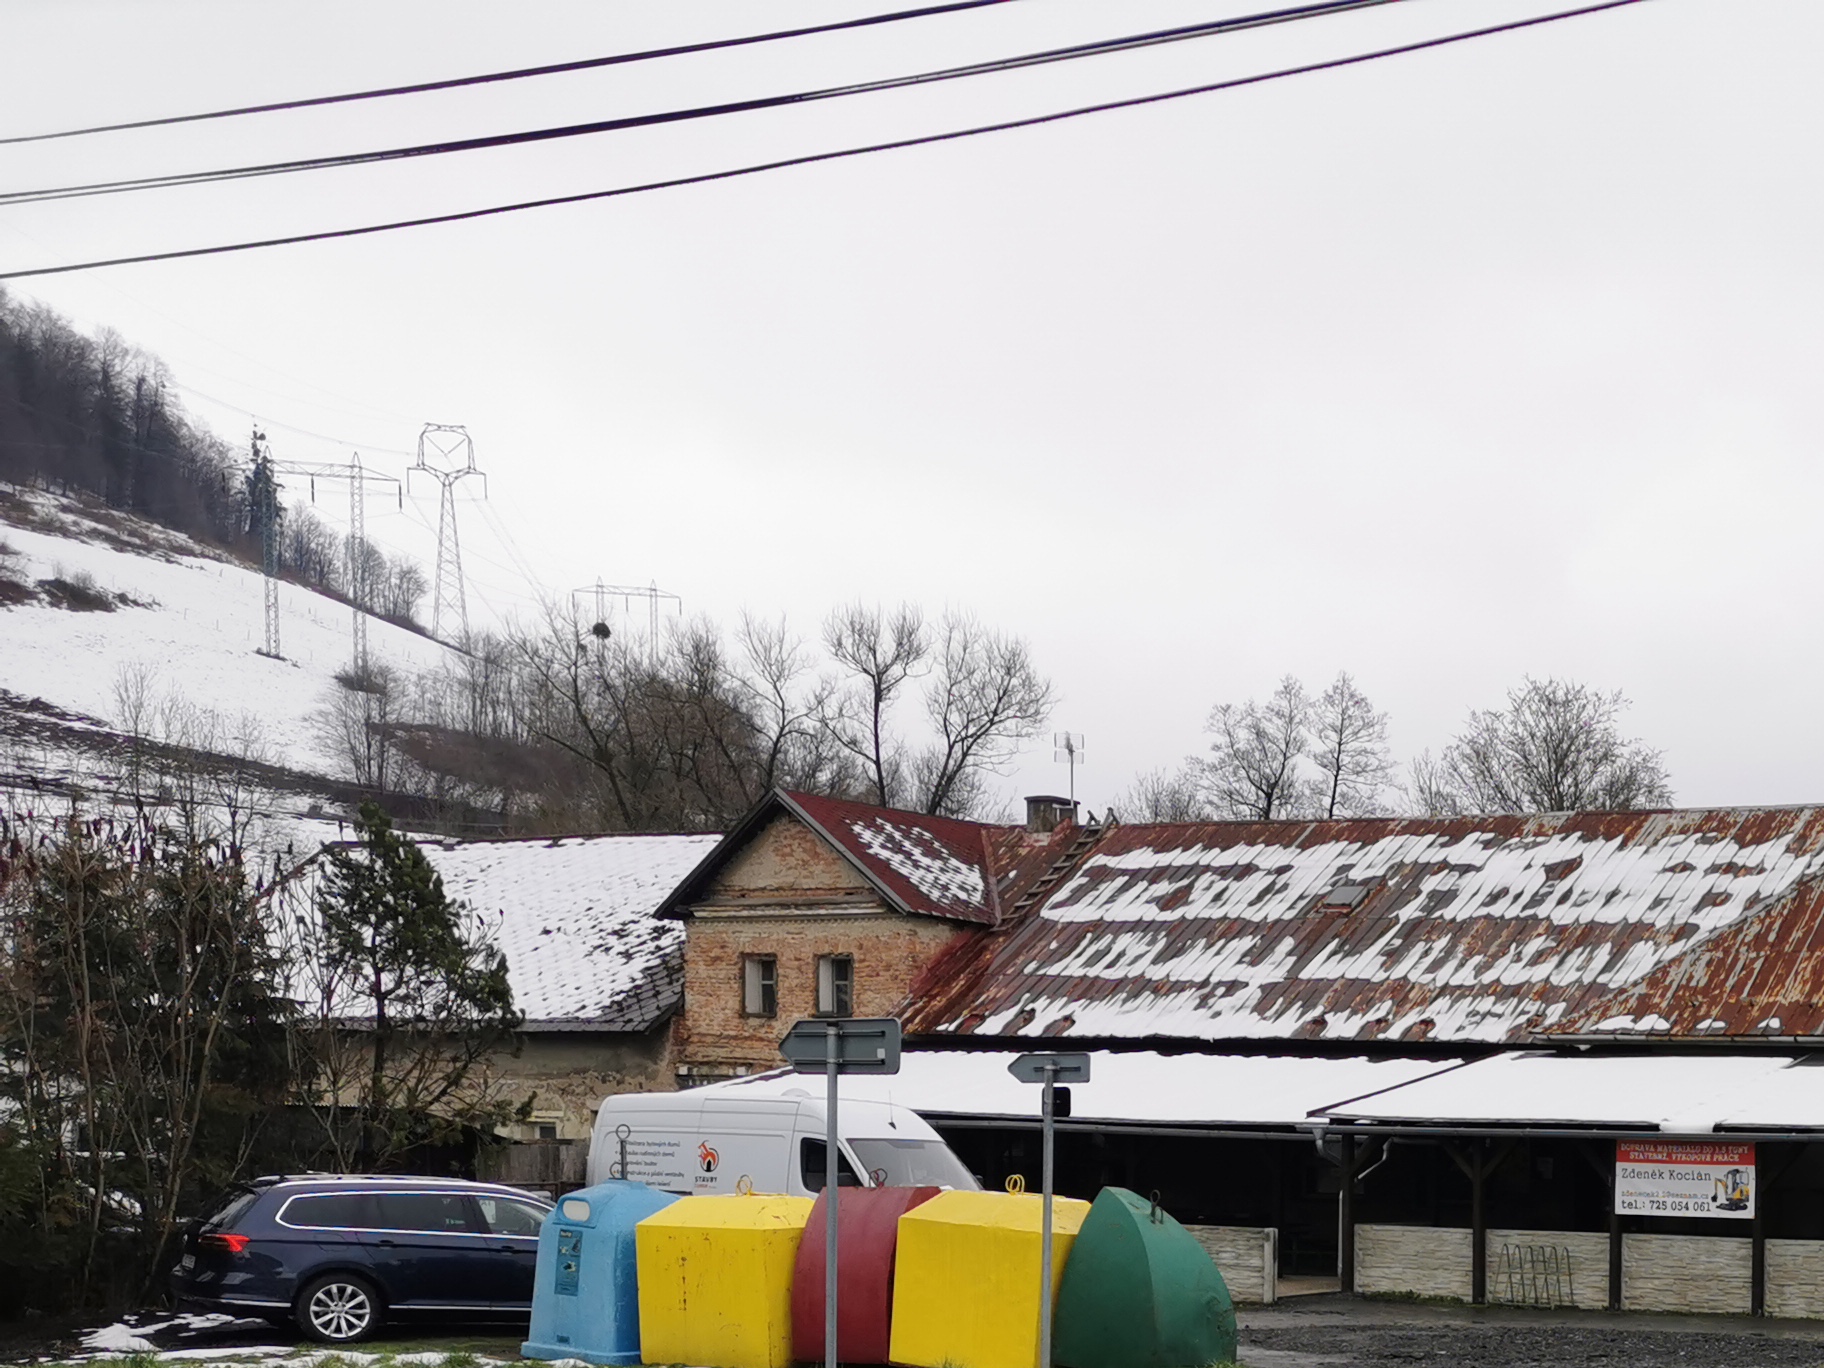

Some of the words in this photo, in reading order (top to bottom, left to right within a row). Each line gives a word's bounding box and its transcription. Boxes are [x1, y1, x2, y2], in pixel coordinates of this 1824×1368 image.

[1621, 1143, 1655, 1152] DOPRAVA
[1702, 1145, 1713, 1154] DO
[1728, 1146, 1748, 1155] TUNY
[694, 1175, 718, 1183] STAVBY
[1621, 1168, 1666, 1181] Zdeněk
[1668, 1169, 1712, 1182] Kocián
[1621, 1200, 1646, 1209] tel.:
[1649, 1200, 1668, 1211] 725
[1670, 1201, 1690, 1211] 054
[1692, 1202, 1712, 1212] 061
